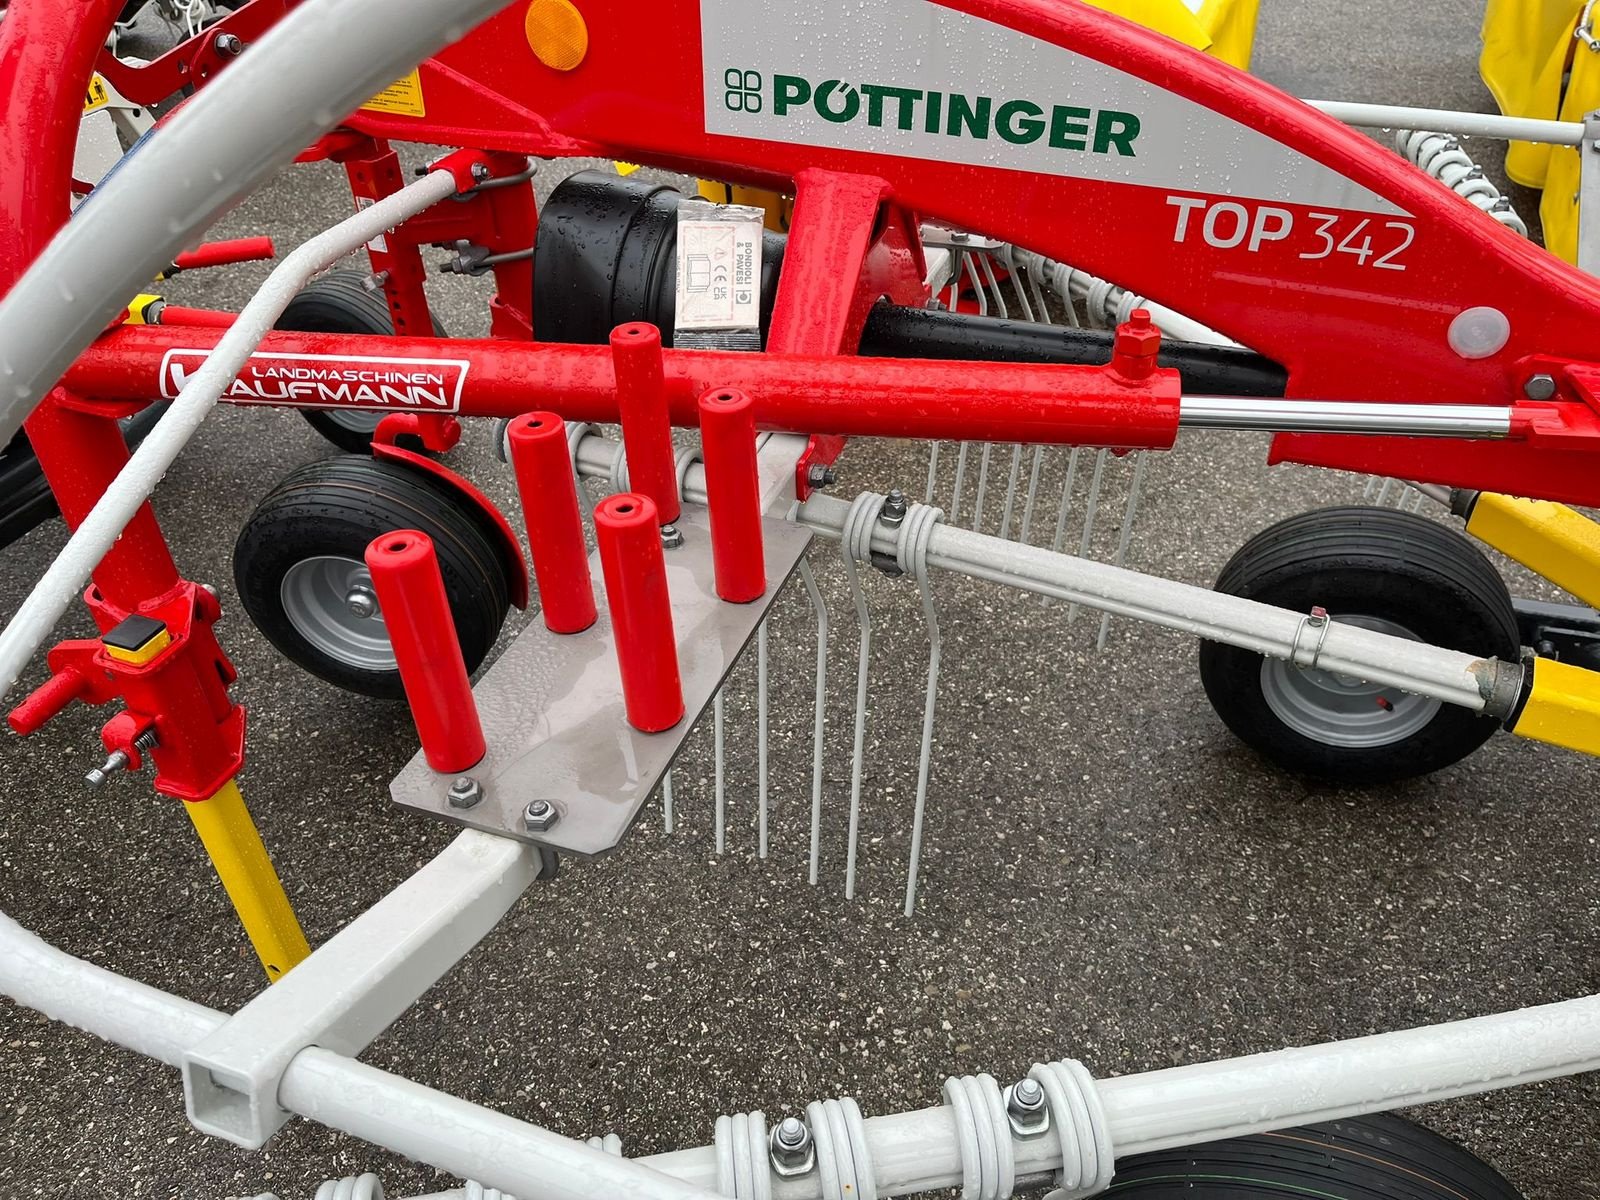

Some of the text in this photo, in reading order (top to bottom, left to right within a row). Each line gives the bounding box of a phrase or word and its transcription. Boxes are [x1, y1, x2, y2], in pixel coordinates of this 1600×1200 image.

[773, 74, 1141, 157] PÖTTINGER
[1166, 195, 1416, 271] TOP 342
[736, 254, 744, 285] PAVESI
[744, 242, 753, 285] BONDIOLI
[251, 365, 444, 385] LANDMASCHINEN
